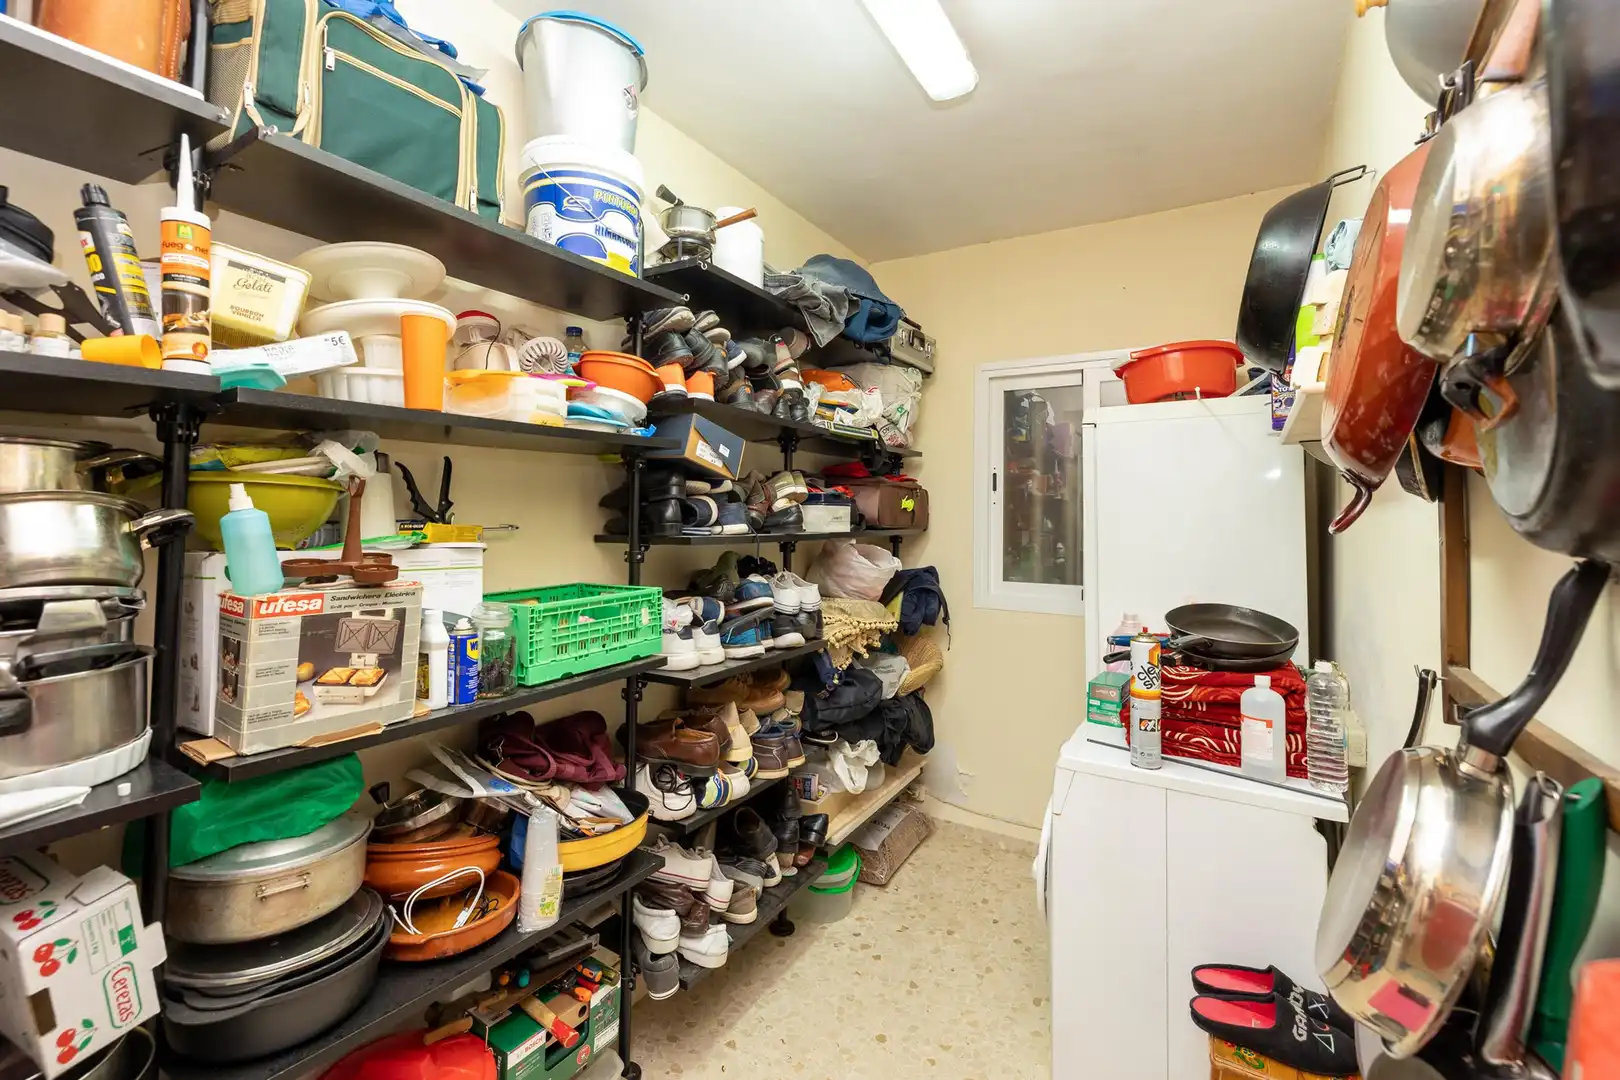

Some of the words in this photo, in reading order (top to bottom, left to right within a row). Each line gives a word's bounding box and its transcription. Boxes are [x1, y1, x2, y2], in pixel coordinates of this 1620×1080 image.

[233, 278, 273, 293] Gelati
[229, 305, 264, 318] BOURBON
[232, 310, 261, 321] VANILLA
[260, 598, 322, 614] ufesa
[112, 966, 134, 1022] Cerezas
[524, 1036, 543, 1053] BOSCH
